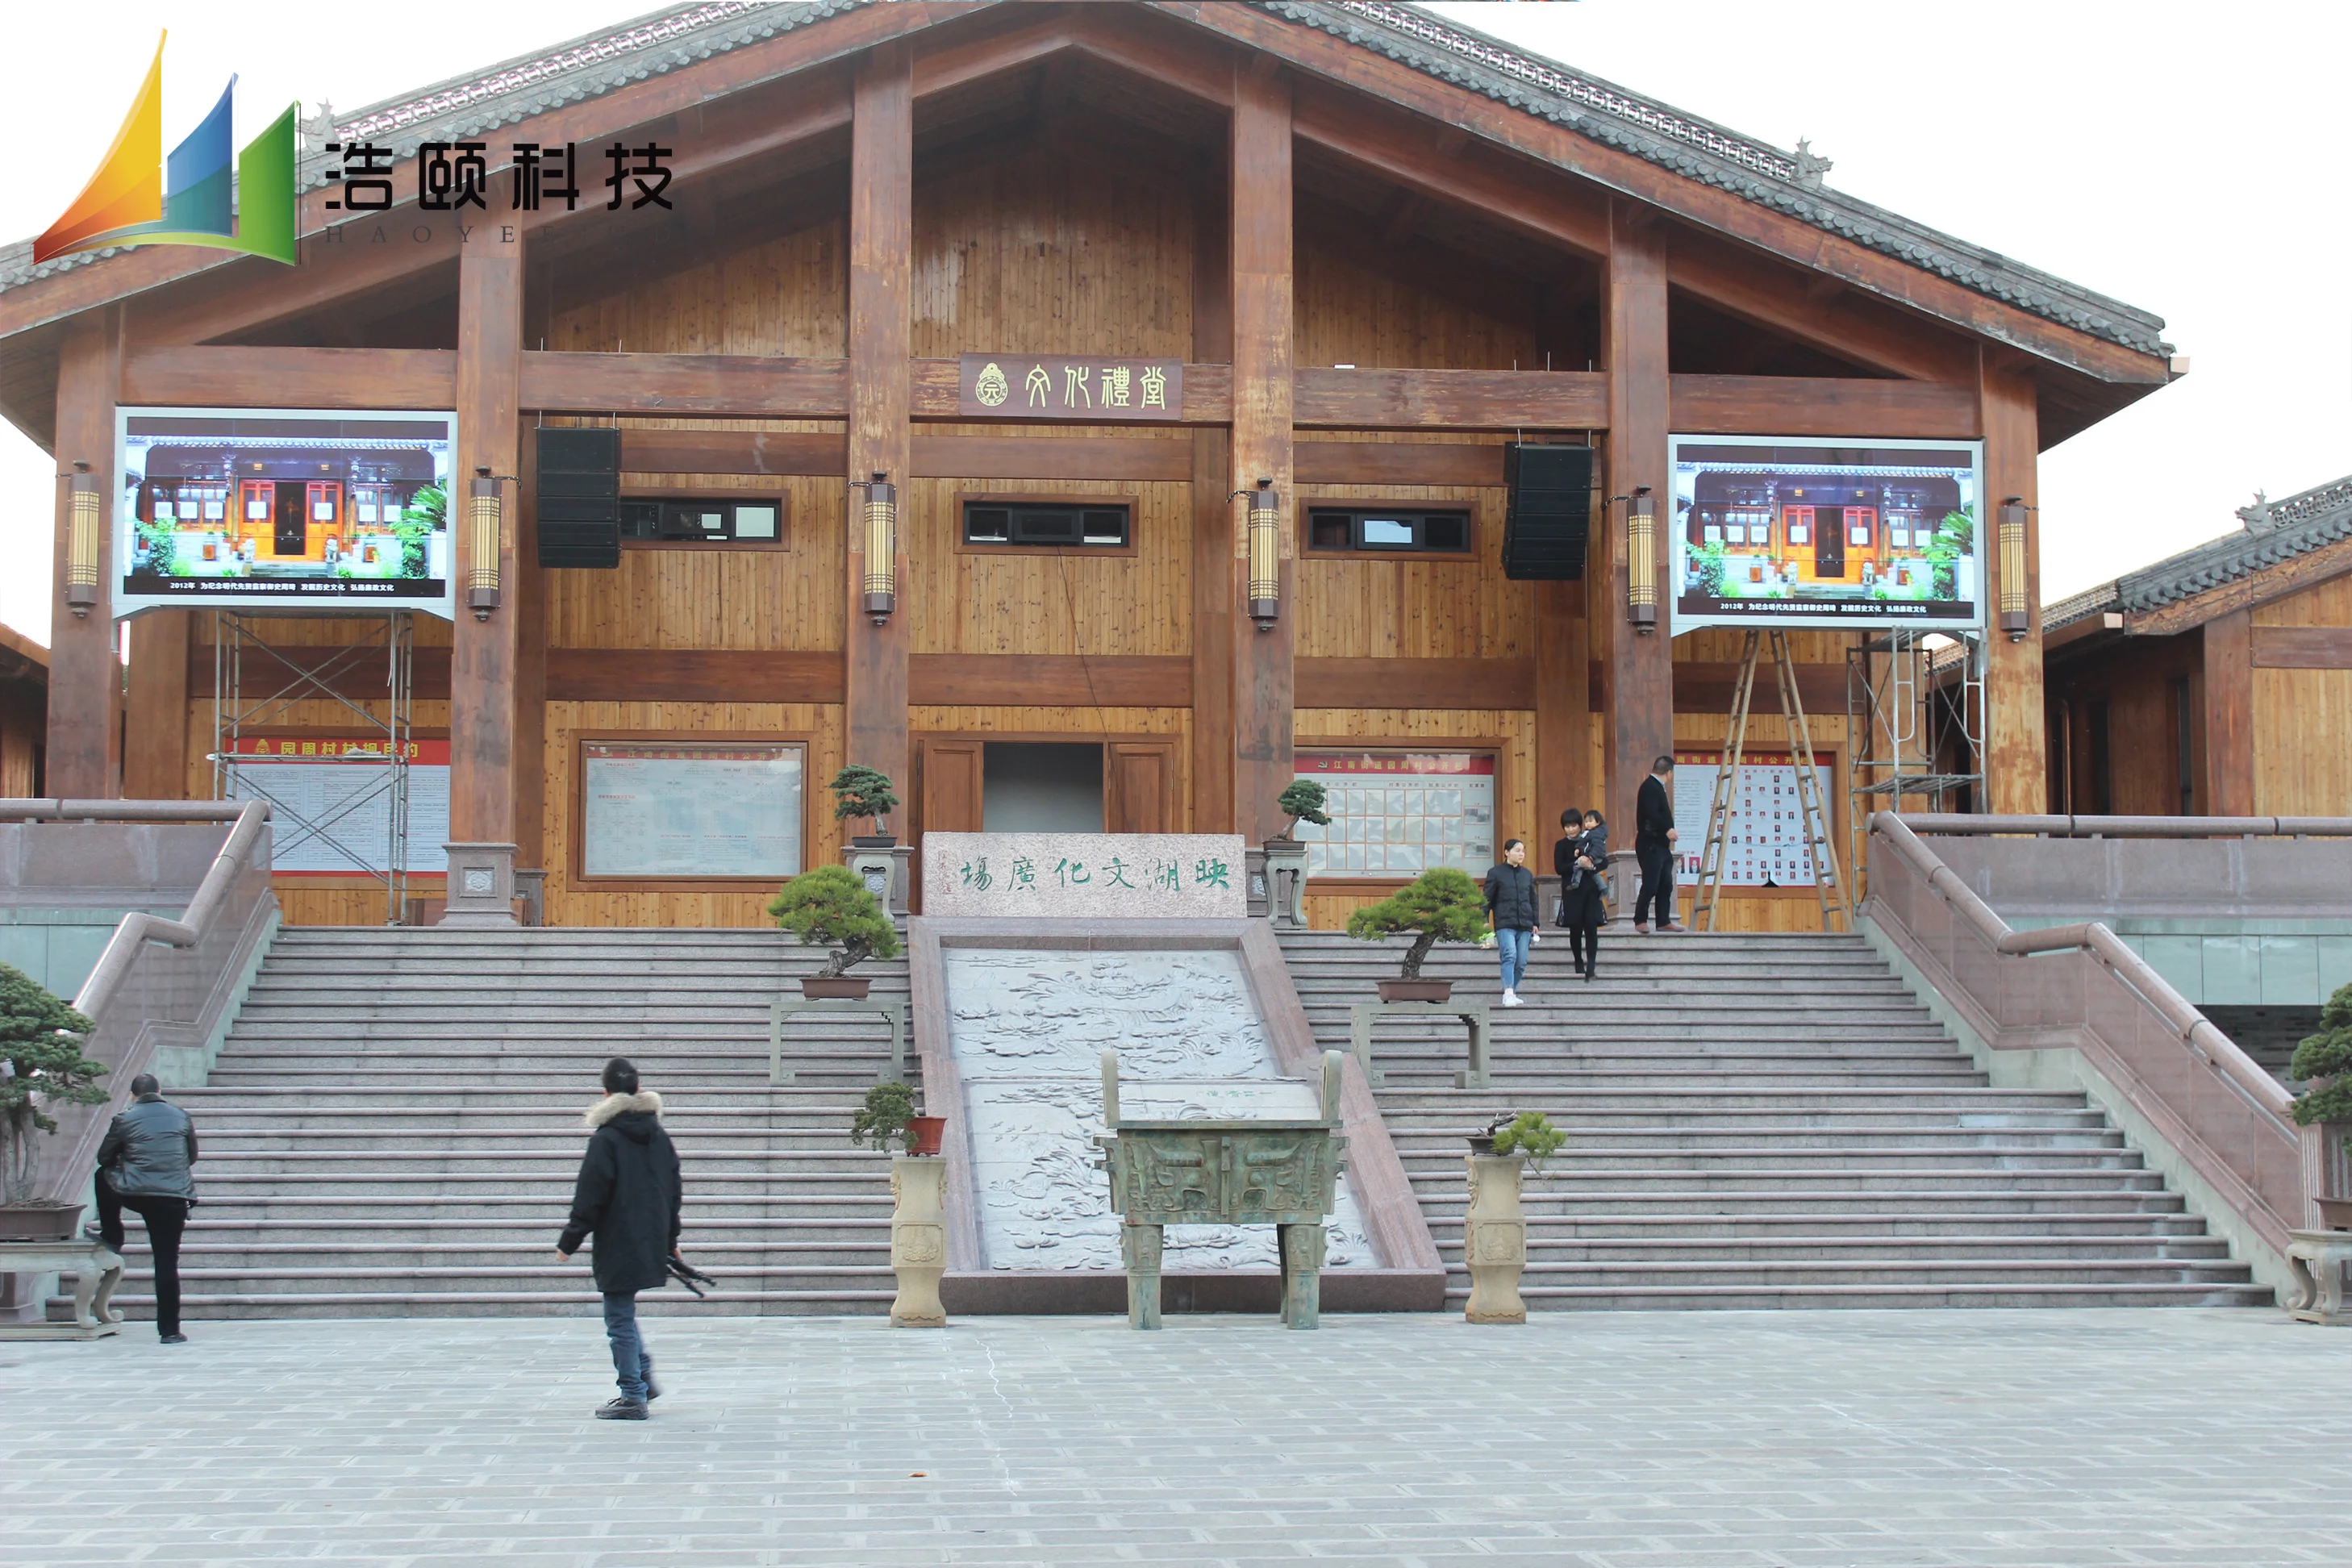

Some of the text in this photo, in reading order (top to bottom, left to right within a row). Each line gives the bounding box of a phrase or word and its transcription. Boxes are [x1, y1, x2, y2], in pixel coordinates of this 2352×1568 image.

[1024, 363, 1168, 411] 文化禮堂
[169, 582, 196, 590] 2012年
[1720, 603, 1744, 611] 2012年
